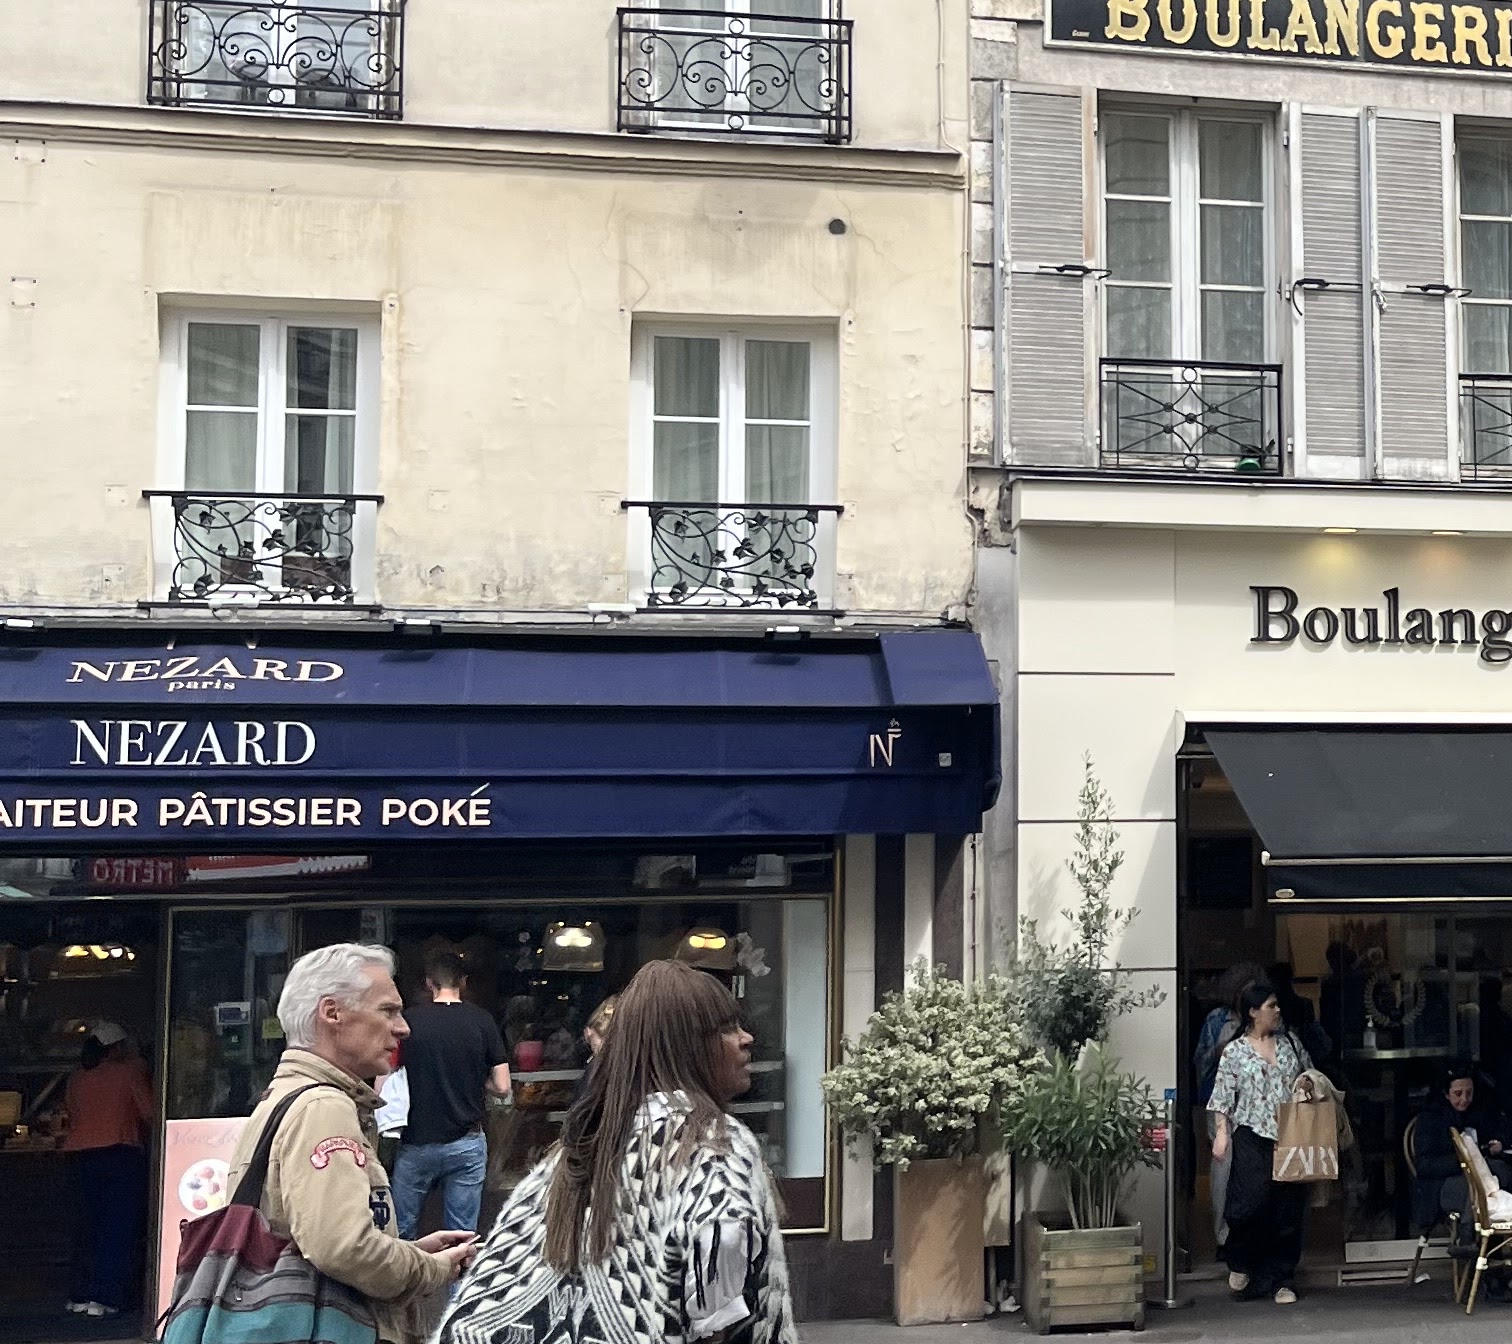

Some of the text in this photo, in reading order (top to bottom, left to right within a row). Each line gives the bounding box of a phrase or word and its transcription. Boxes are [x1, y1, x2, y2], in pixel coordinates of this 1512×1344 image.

[65, 656, 345, 683] NEZARD
[167, 679, 236, 693] paris
[69, 719, 317, 766] NEZARD
[159, 791, 362, 827] PÂTISSIER
[382, 782, 492, 827] POKÉ
